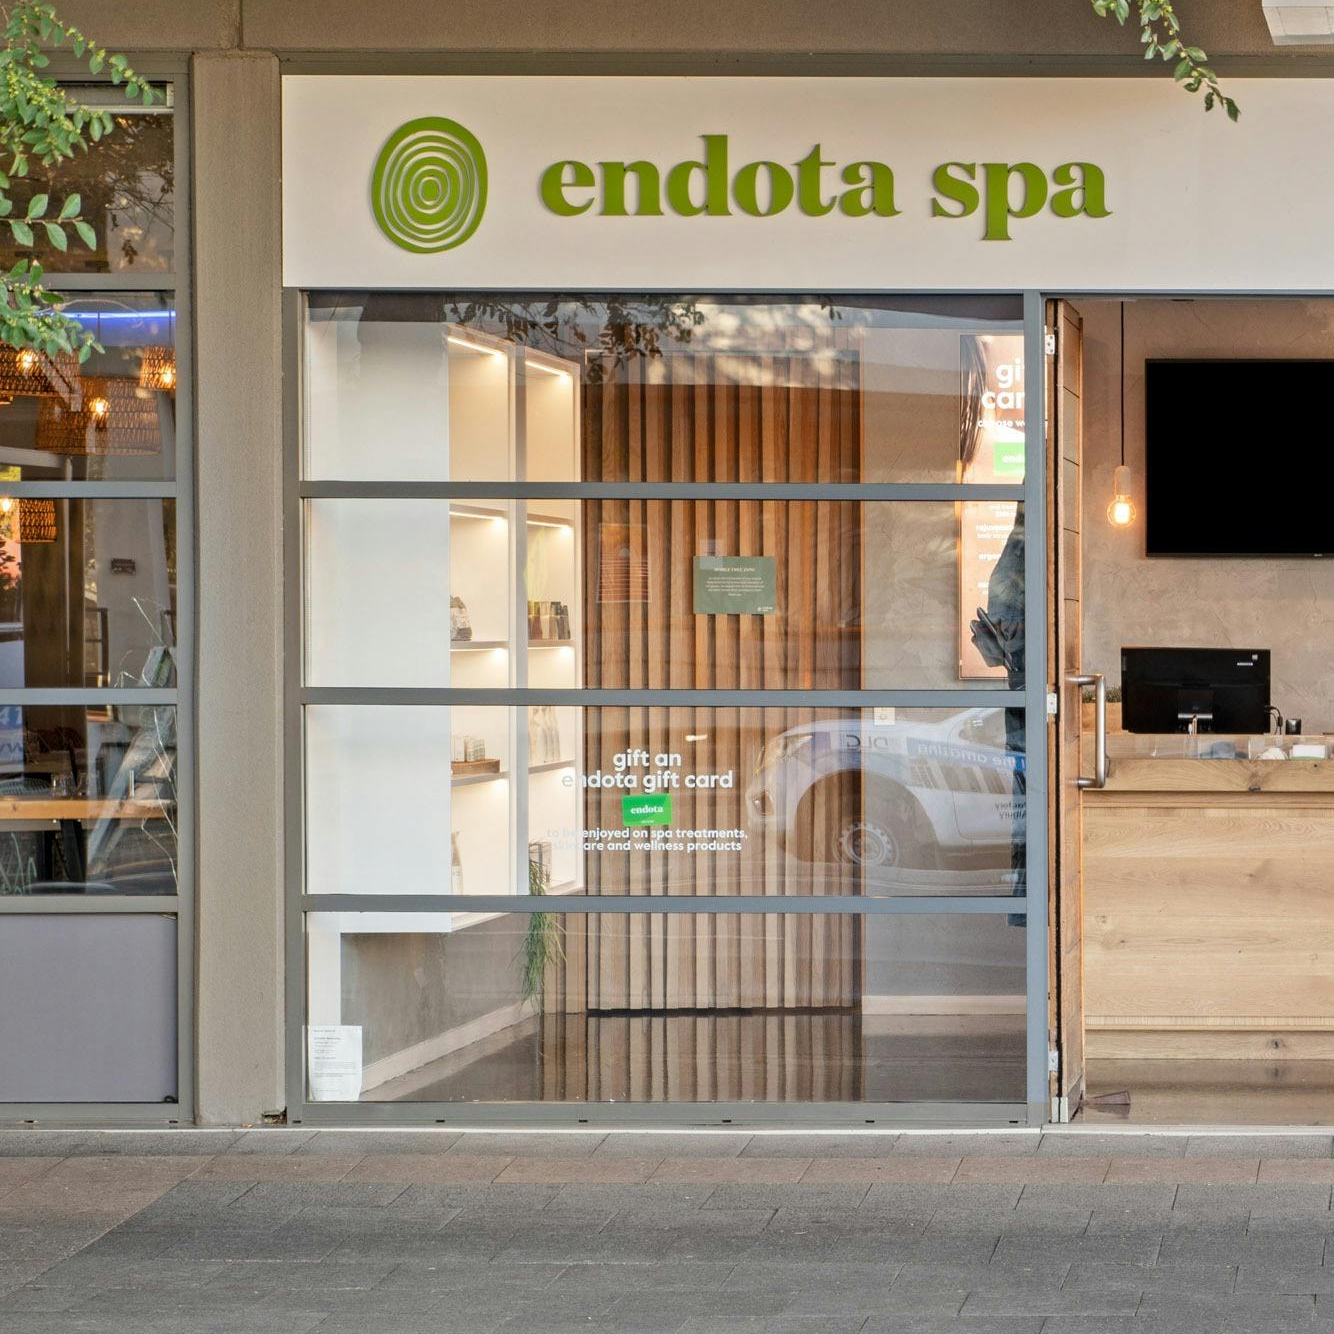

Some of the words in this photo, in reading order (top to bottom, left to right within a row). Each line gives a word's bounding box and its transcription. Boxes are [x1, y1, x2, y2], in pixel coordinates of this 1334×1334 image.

[539, 134, 902, 217] endota
[931, 161, 1114, 241] spa
[996, 357, 1024, 388] gi
[612, 748, 650, 771] gift
[654, 753, 682, 767] an
[561, 770, 638, 788] endota
[642, 770, 680, 793] gift
[684, 770, 733, 788] card
[630, 804, 664, 815] endota
[582, 827, 630, 840] enjoyed
[632, 830, 648, 838] on
[651, 830, 673, 841] spa
[675, 828, 748, 839] treatments,
[607, 840, 631, 851] and
[634, 840, 684, 851] wellness
[687, 840, 742, 853] products
